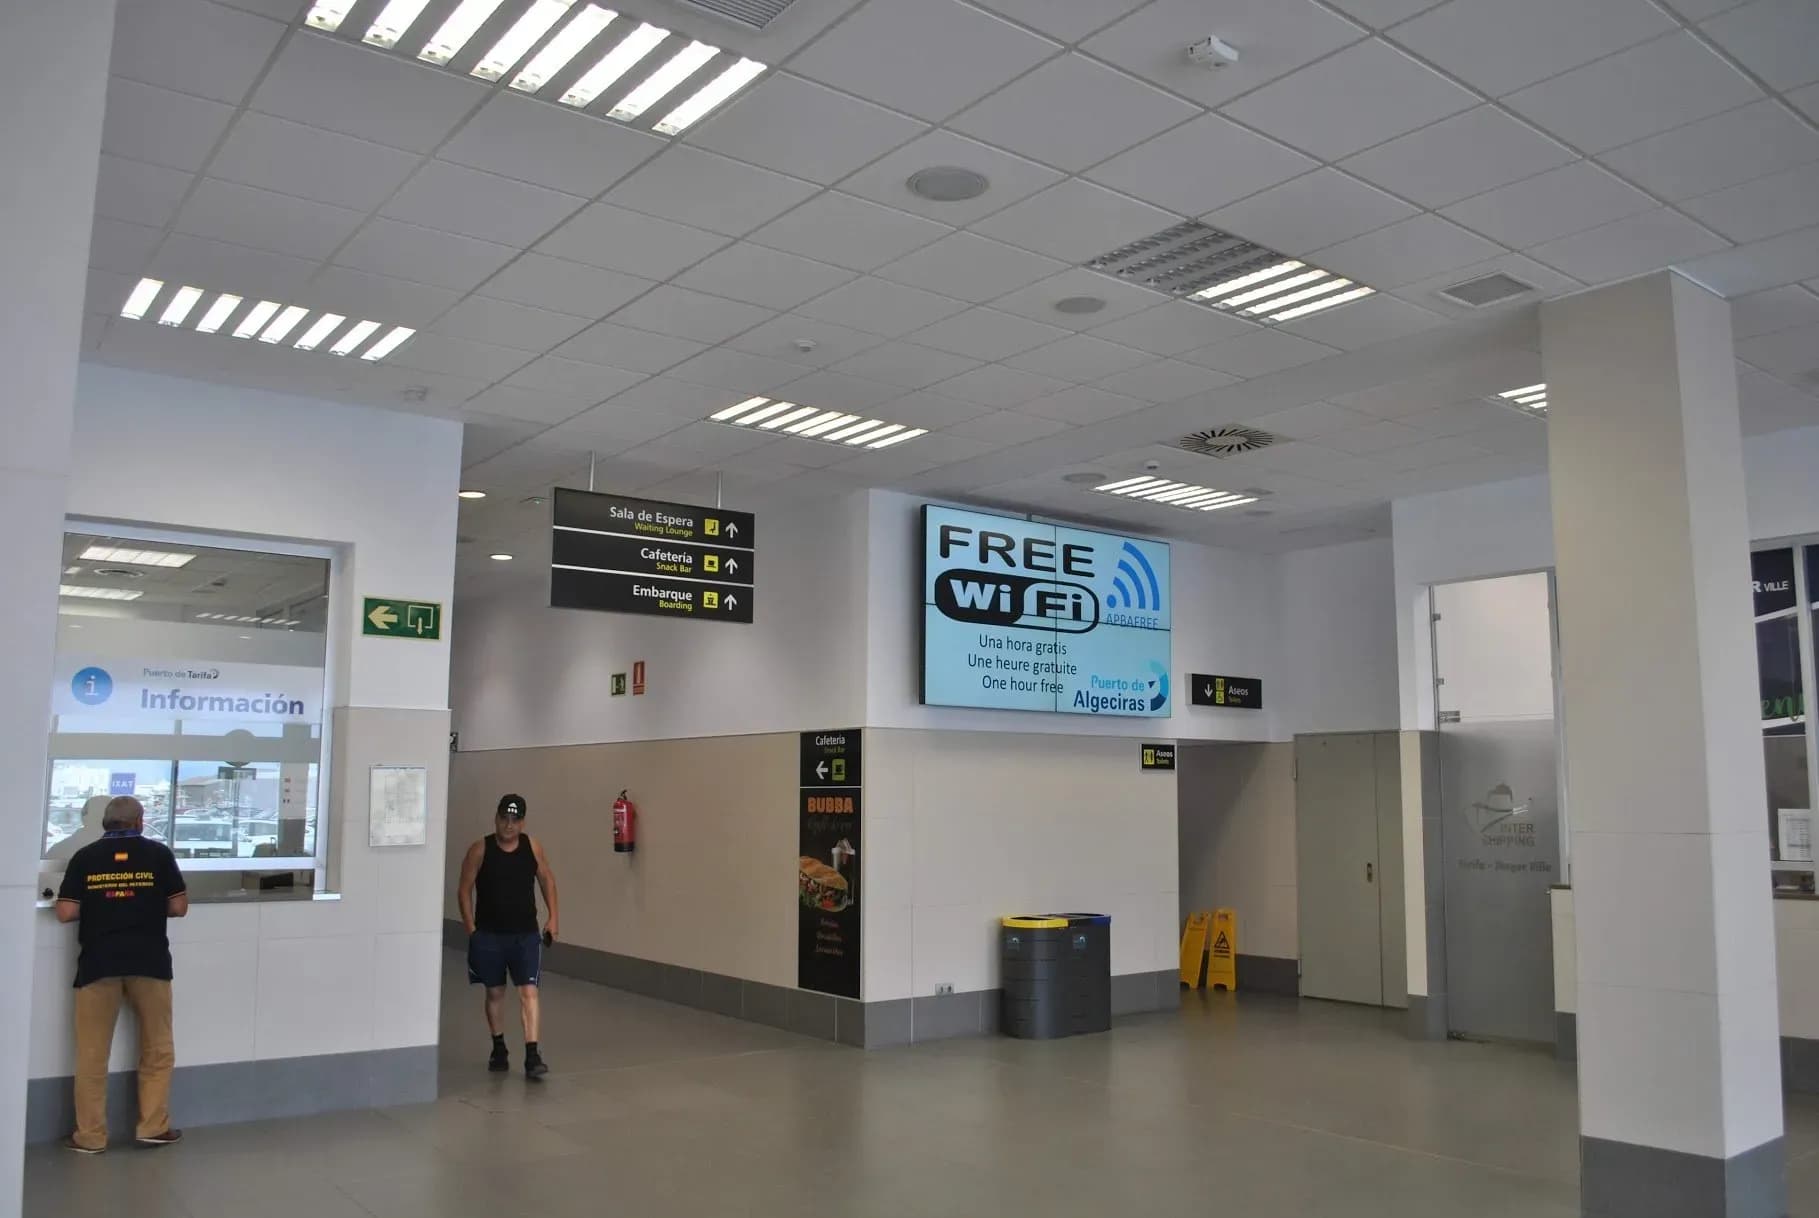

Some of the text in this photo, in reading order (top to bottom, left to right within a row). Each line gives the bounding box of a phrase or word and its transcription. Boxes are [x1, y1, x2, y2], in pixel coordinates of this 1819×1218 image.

[609, 506, 694, 528] Sala de Espera
[634, 521, 694, 538] Waiting Lounge
[640, 547, 693, 564] Cafetería
[939, 524, 1096, 578] FREE
[655, 561, 692, 573] Snack Bar
[632, 584, 693, 602] Embarque
[1763, 579, 1790, 592] VILLE
[659, 599, 693, 612] Boarding
[1106, 612, 1159, 630] APBAFREE
[978, 633, 1067, 656] Una hora gratis
[967, 653, 1078, 675] Une heure gratuite
[143, 667, 212, 680] Puerto de Tarifa
[982, 675, 1064, 694] One hour free
[1091, 674, 1145, 692] Puerto de
[1228, 685, 1249, 697] Aseos
[140, 688, 304, 715] Información
[1073, 690, 1145, 712] Algeciras
[807, 796, 854, 814] BUBBA
[1500, 823, 1534, 833] INTER
[87, 871, 154, 882] PROTECCIÓN CIVIL
